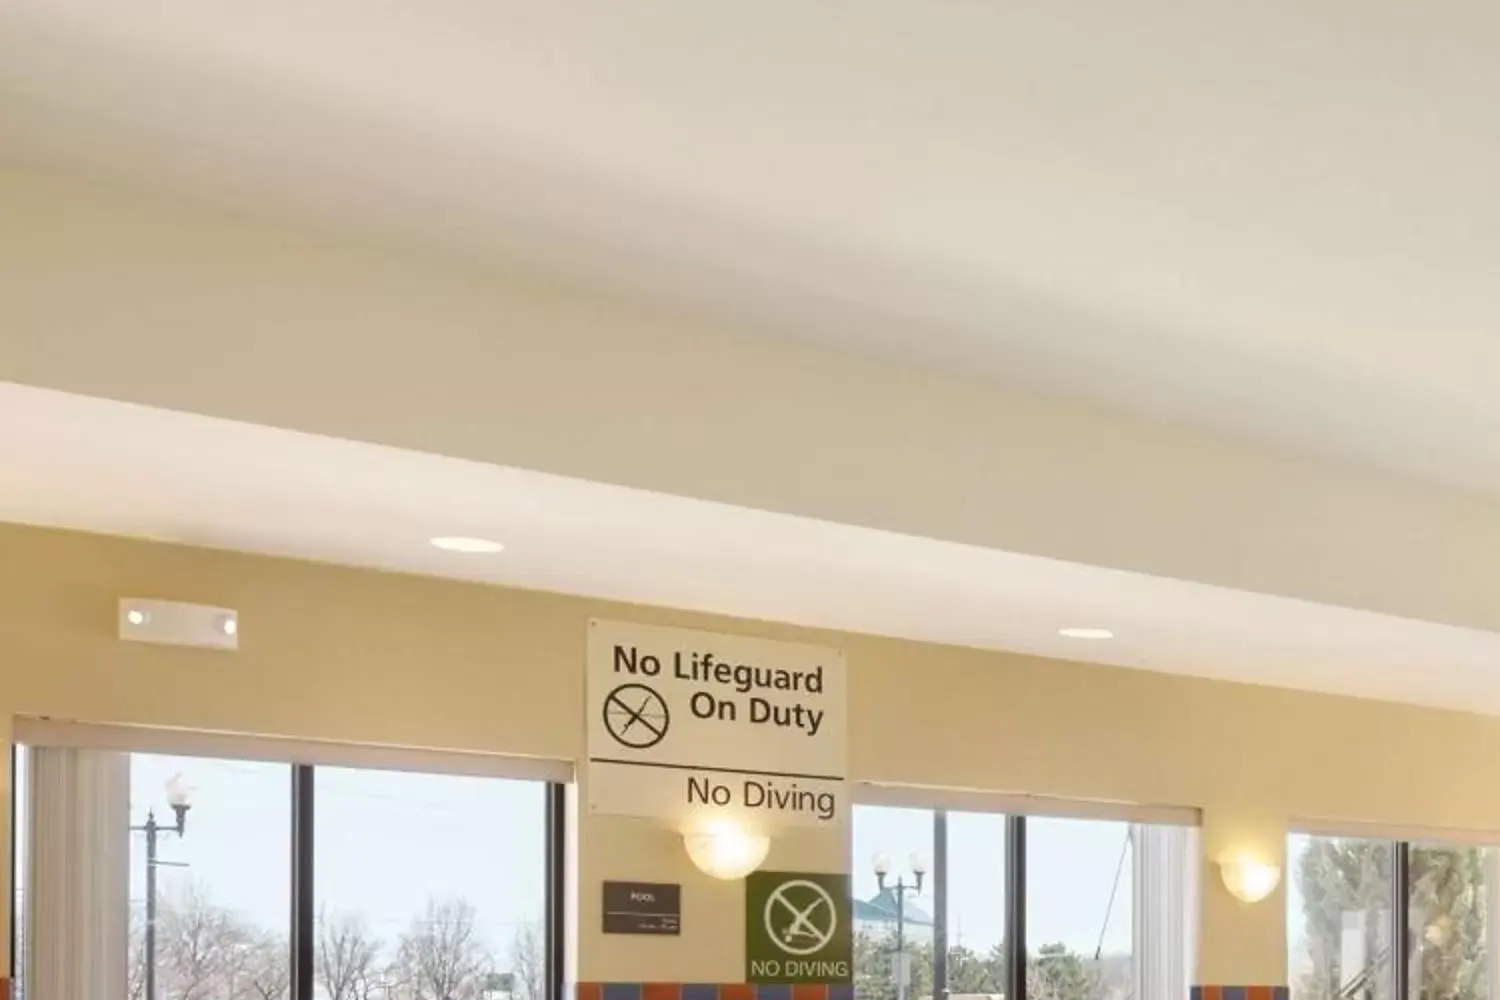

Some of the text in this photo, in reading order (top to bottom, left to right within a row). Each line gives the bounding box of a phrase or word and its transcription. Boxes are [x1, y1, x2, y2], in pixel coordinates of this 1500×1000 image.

[613, 645, 823, 695] No Lifeguard
[690, 691, 824, 736] On Duty
[687, 776, 836, 820] No Diving
[751, 959, 849, 977] NO DIVING
